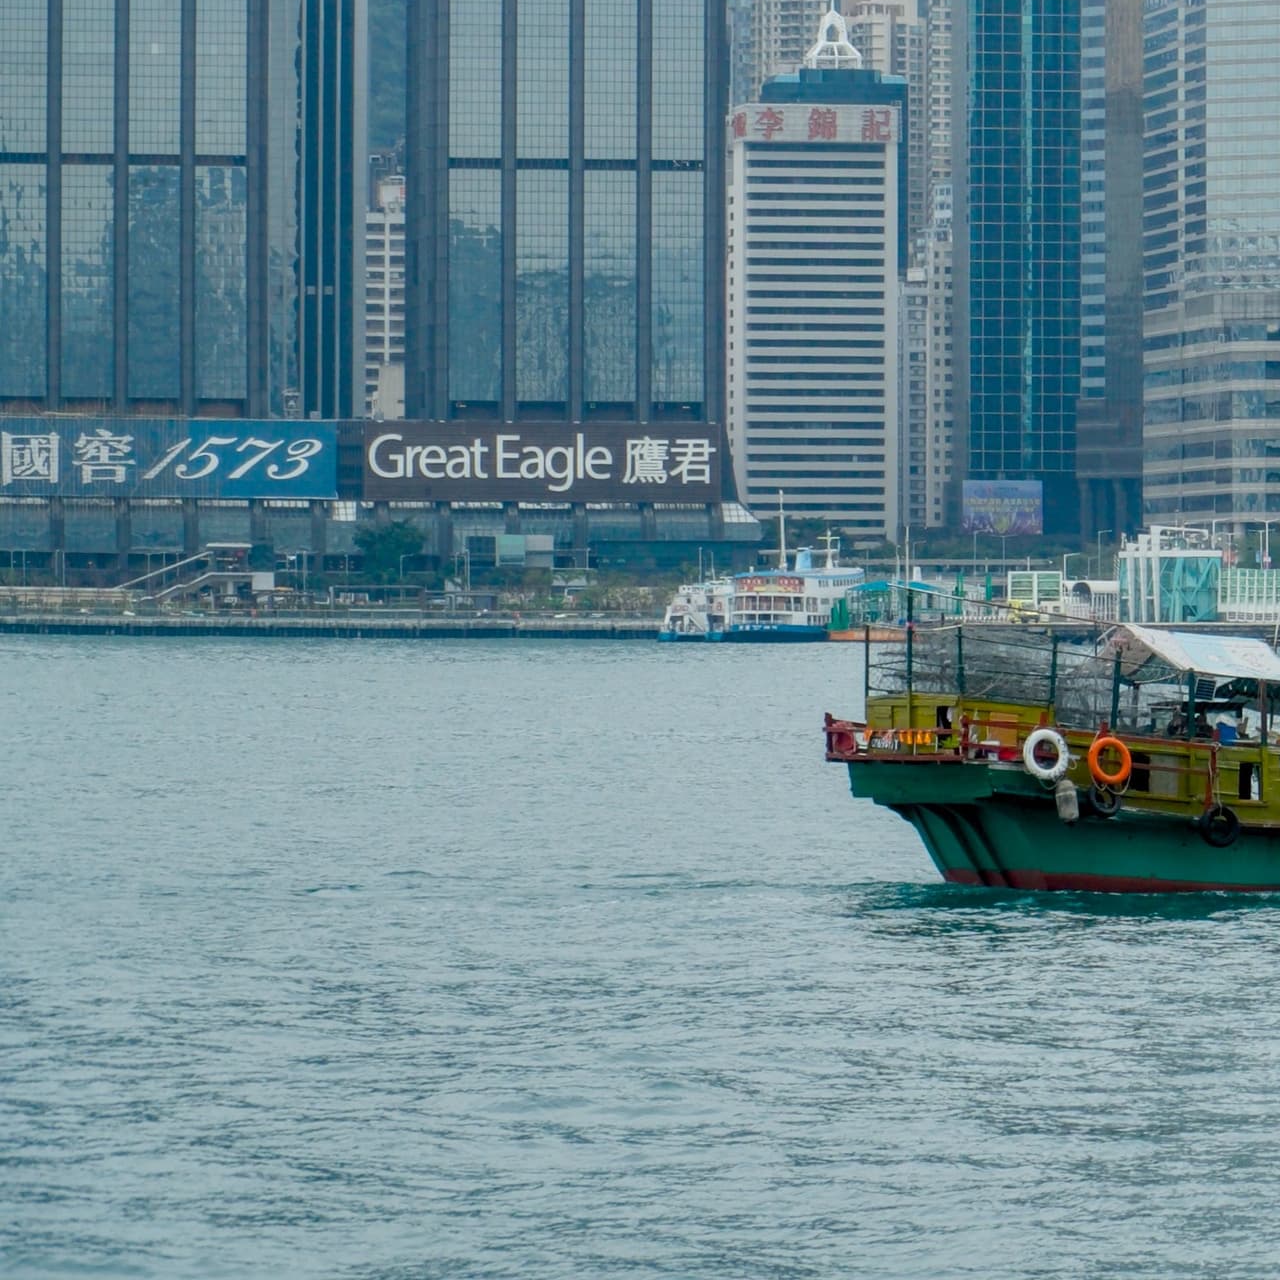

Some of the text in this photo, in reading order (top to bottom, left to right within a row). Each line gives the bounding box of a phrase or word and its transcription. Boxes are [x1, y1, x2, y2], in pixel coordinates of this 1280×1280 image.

[752, 106, 893, 142] 李錦記
[367, 432, 717, 492] Great Eagle 鷹君
